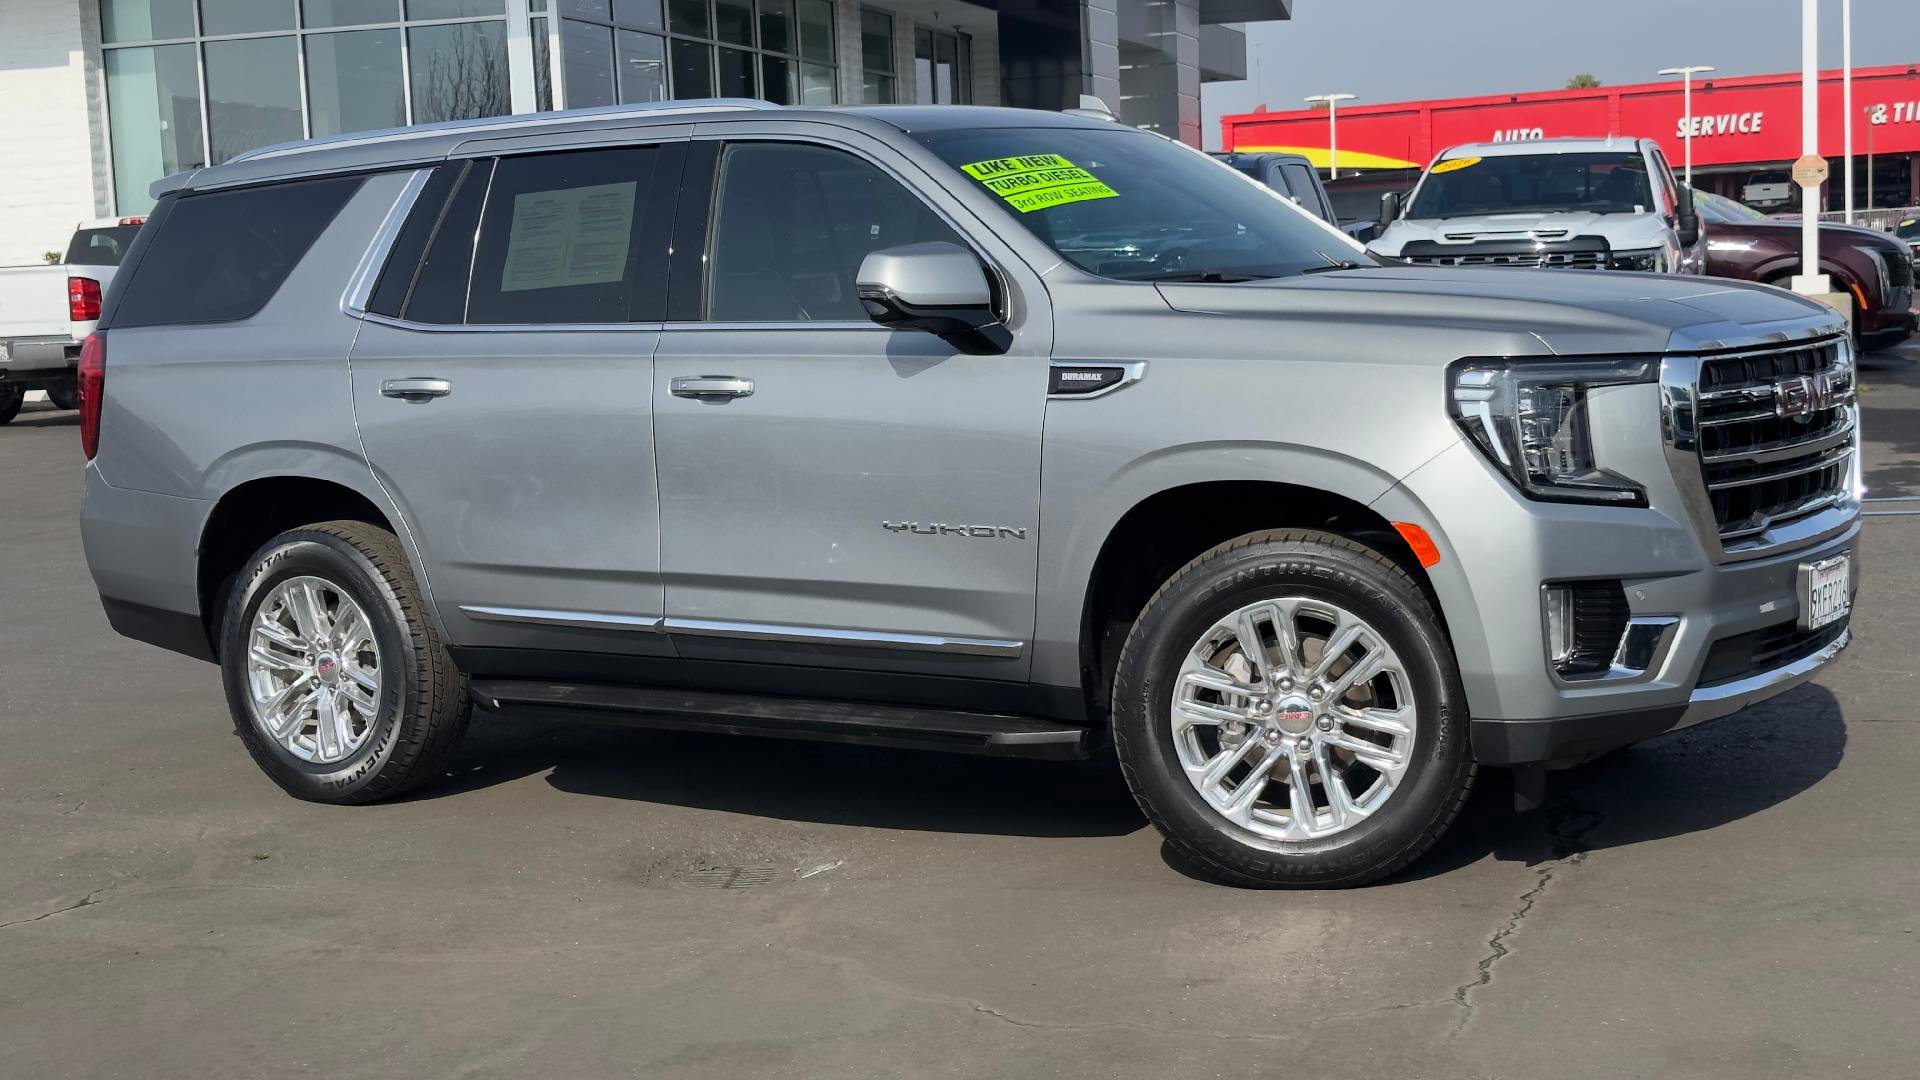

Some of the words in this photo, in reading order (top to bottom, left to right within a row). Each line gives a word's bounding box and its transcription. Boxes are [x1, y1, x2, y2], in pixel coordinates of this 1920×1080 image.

[1493, 127, 1544, 143] AUTO
[1675, 111, 1764, 138] SERVICE
[1871, 103, 1888, 125] &
[1892, 100, 1920, 123] TI
[972, 159, 1013, 176] LIKE
[1016, 155, 1060, 168] NEW
[987, 174, 1039, 191] TURBO
[1041, 169, 1089, 183] DIESEL
[1014, 196, 1036, 209] 3rd
[1037, 191, 1064, 204] ROW
[1064, 185, 1111, 198] SEATING
[1061, 372, 1103, 381] DURAMAX
[1775, 368, 1854, 417] GMC
[882, 520, 1027, 540] YUKON
